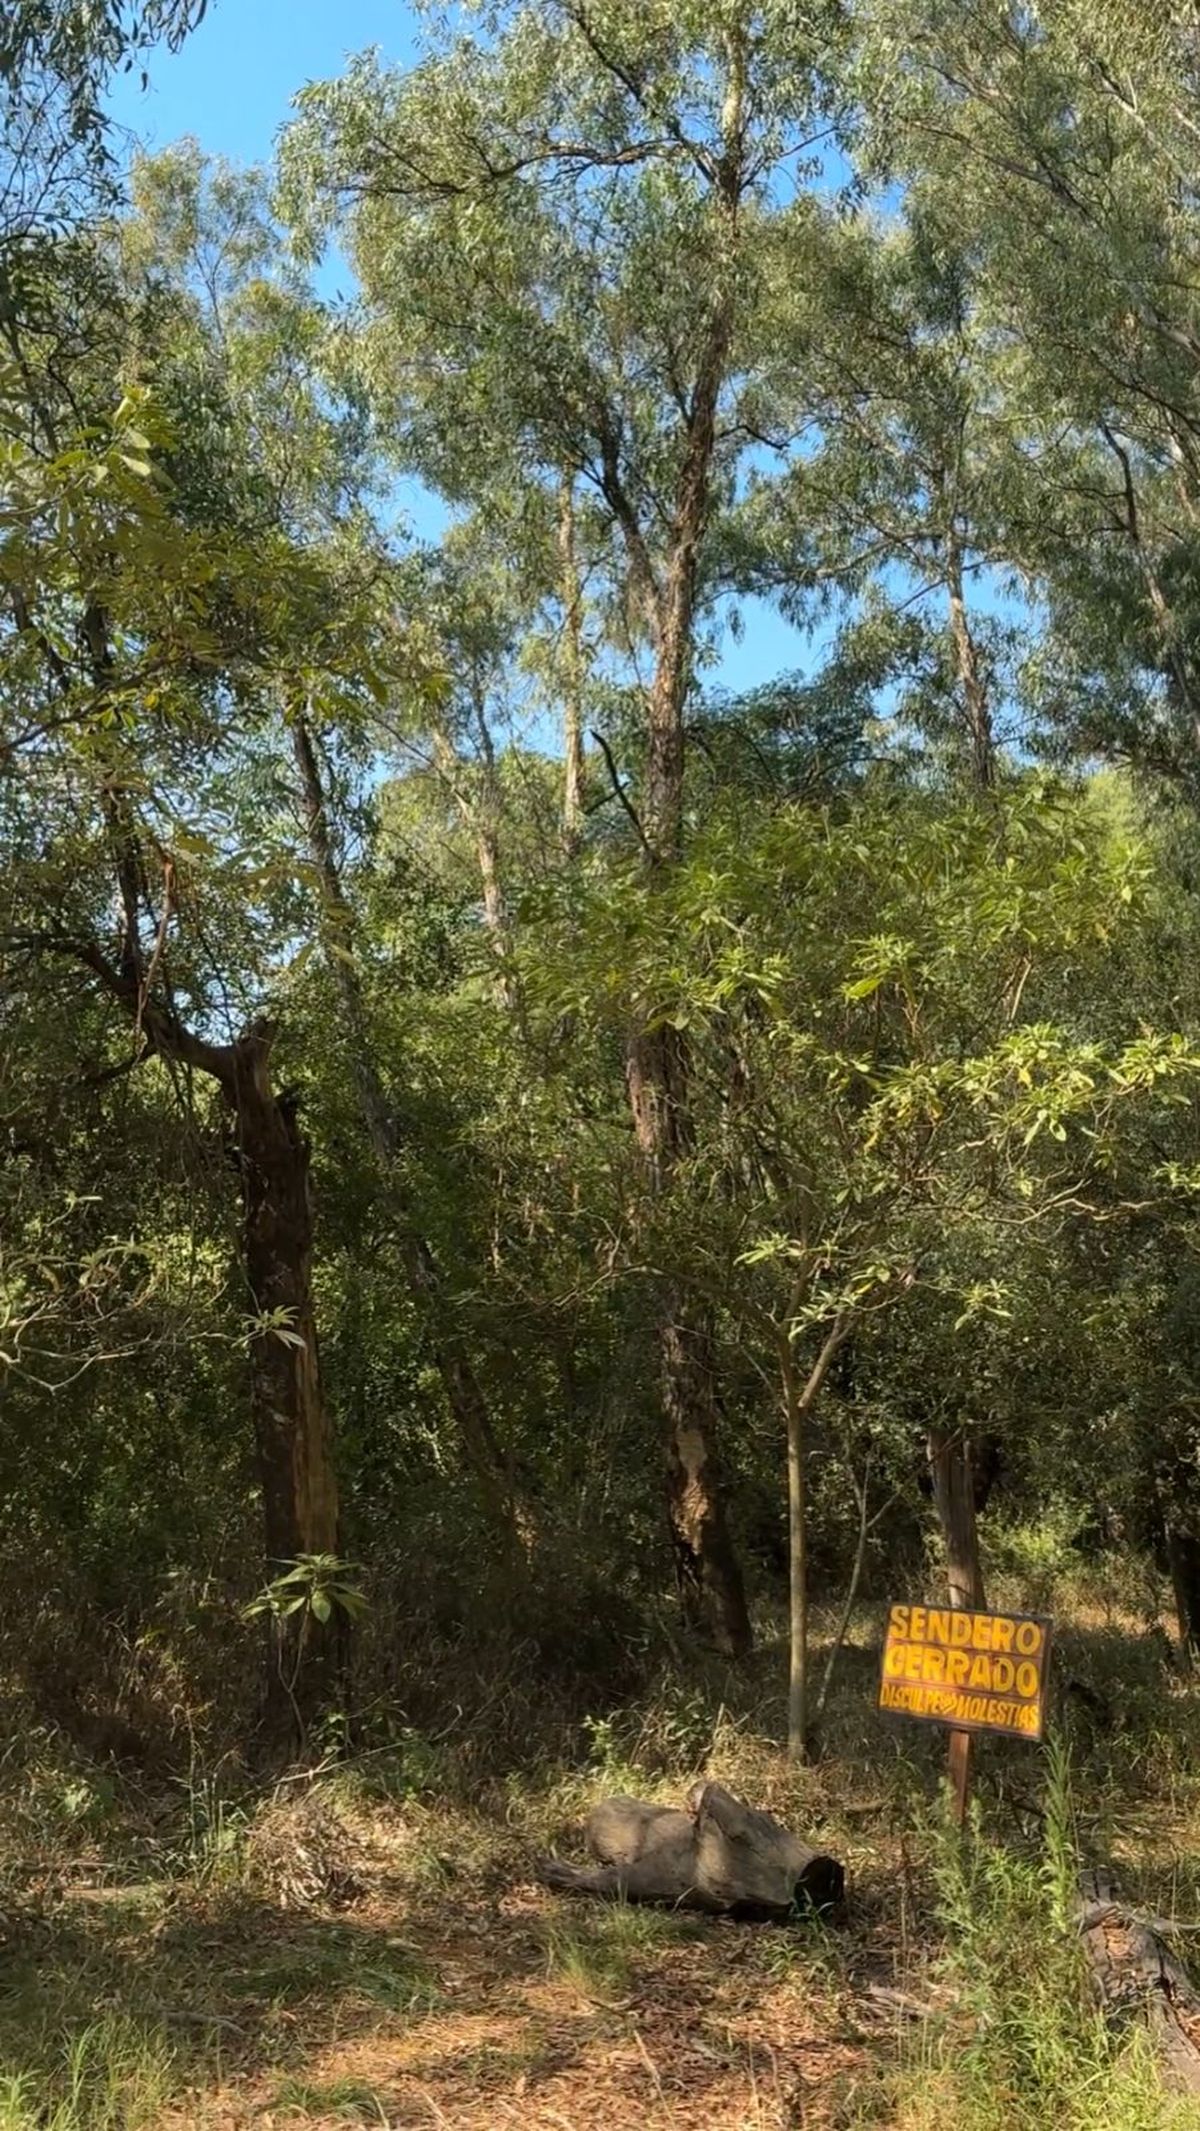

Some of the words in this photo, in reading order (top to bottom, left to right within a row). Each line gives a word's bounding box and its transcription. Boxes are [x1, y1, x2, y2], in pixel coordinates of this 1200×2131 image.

[889, 1605, 1041, 1655] SENDERO
[884, 1644, 1038, 1698] CERRADO
[956, 1695, 1039, 1730] MOLESTIAS
